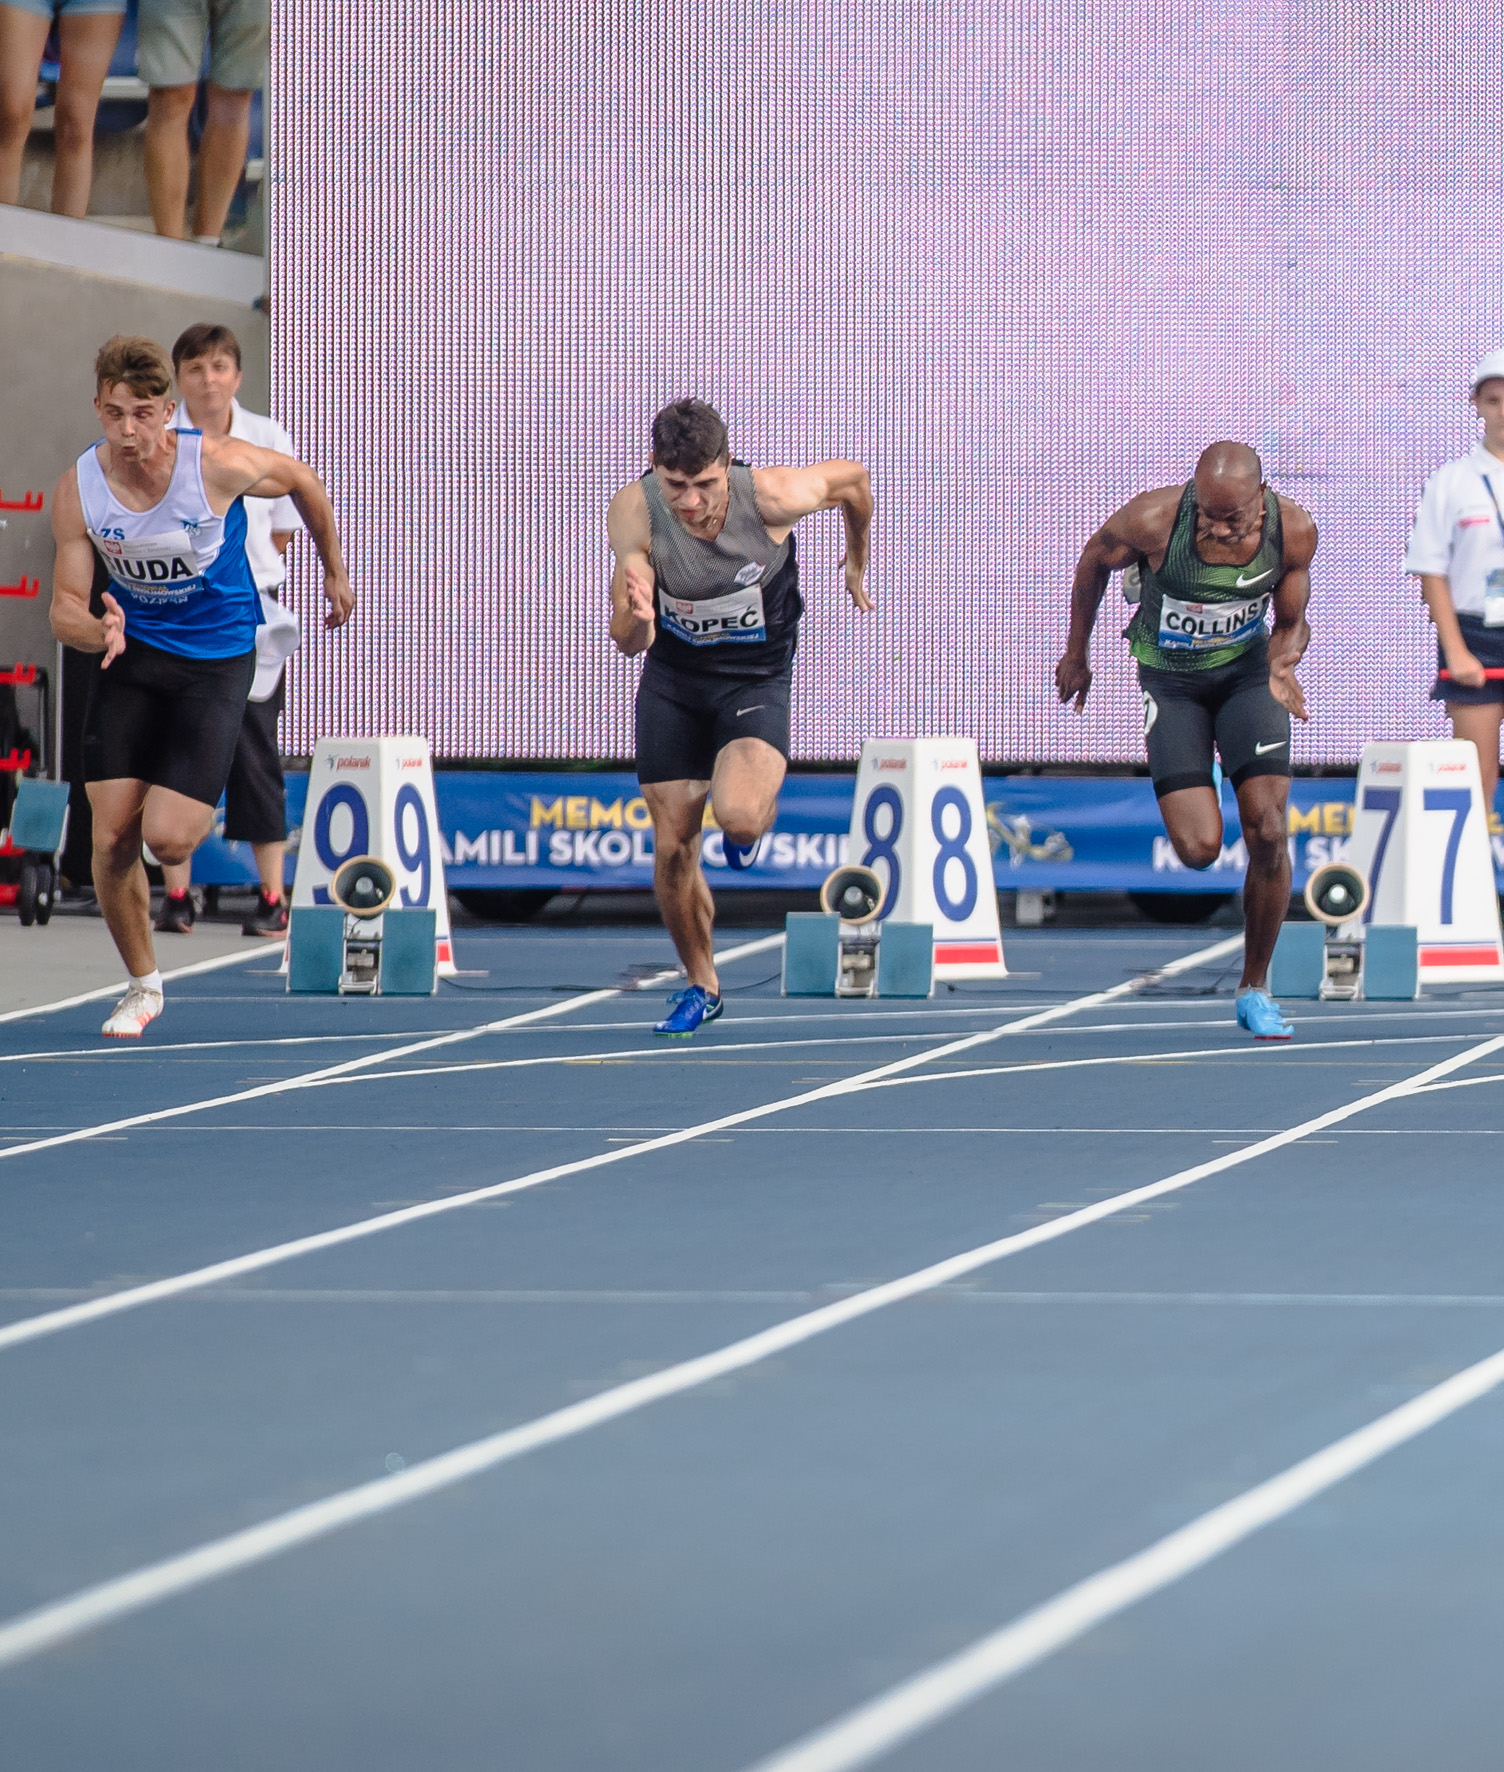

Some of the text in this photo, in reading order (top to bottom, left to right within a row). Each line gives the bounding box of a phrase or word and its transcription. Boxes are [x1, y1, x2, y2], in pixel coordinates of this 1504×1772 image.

[664, 605, 759, 633] KOPEĆ
[1166, 602, 1258, 635] COLLINS
[394, 783, 431, 907] 9
[931, 786, 978, 922] 8
[1363, 787, 1401, 924] 7
[1423, 788, 1472, 924] 7
